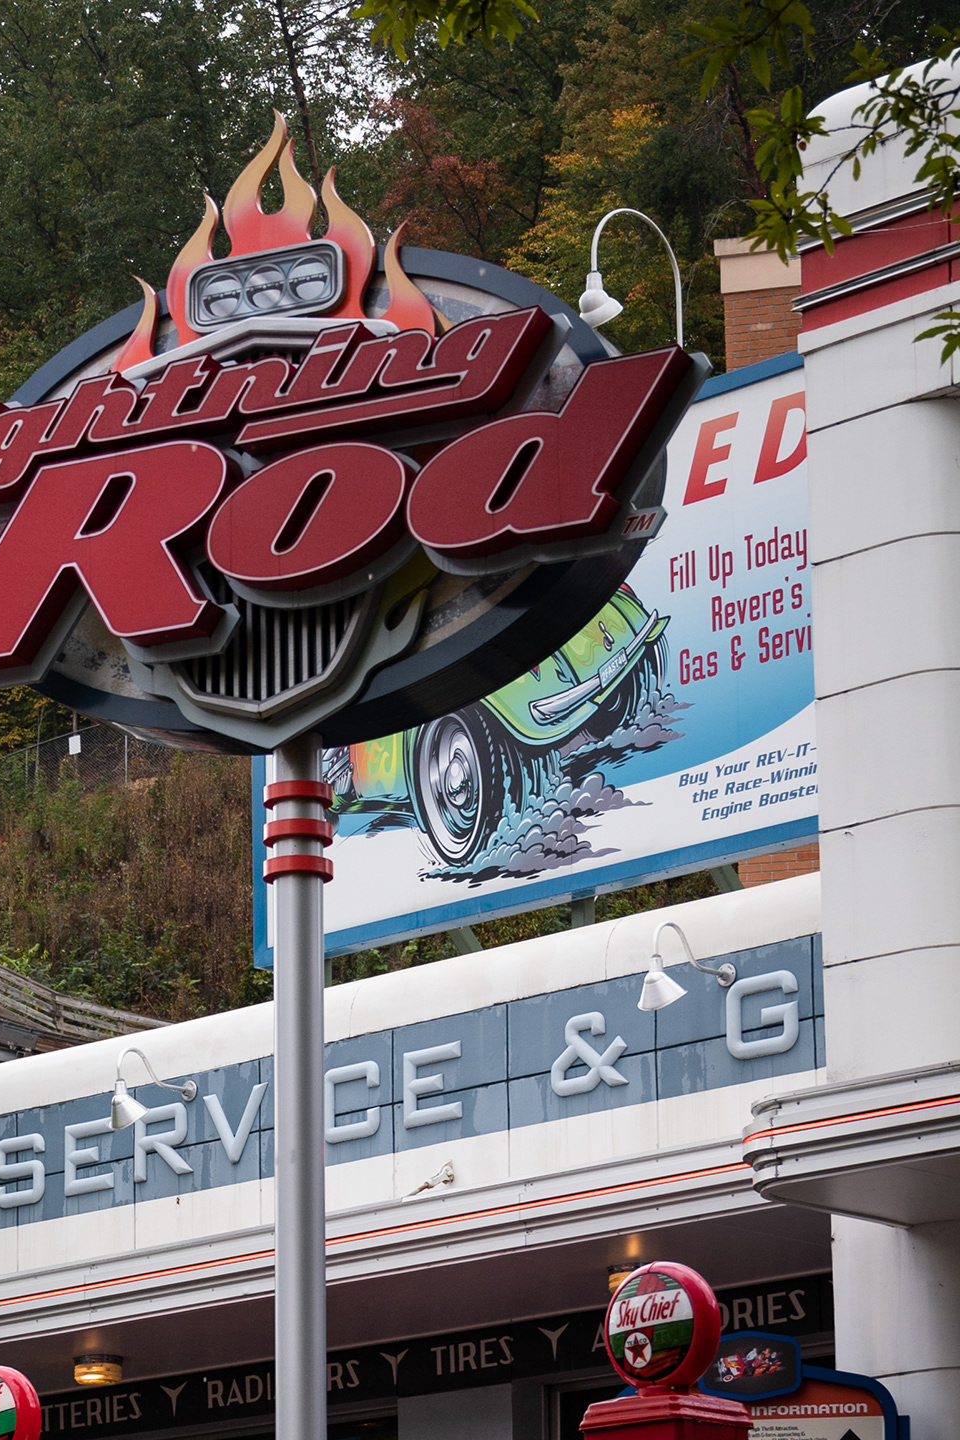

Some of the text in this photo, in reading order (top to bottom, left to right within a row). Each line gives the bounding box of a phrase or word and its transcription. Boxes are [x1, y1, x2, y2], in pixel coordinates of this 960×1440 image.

[621, 511, 657, 536] TM
[669, 526, 808, 593] Fill Up Today
[711, 576, 803, 632] Revere's
[600, 653, 626, 682] 2FAST4U
[679, 648, 718, 685] Gas
[730, 635, 746, 671] &
[678, 742, 817, 788] Buy Your REV-IT-
[692, 788, 719, 804] the
[701, 799, 753, 821] Engine
[550, 1010, 630, 1098] &
[616, 1291, 681, 1328] Sky Chief
[42, 1391, 143, 1434] TTERIES
[430, 1335, 515, 1376] TIRES
[751, 1402, 868, 1417] INFORMATION
